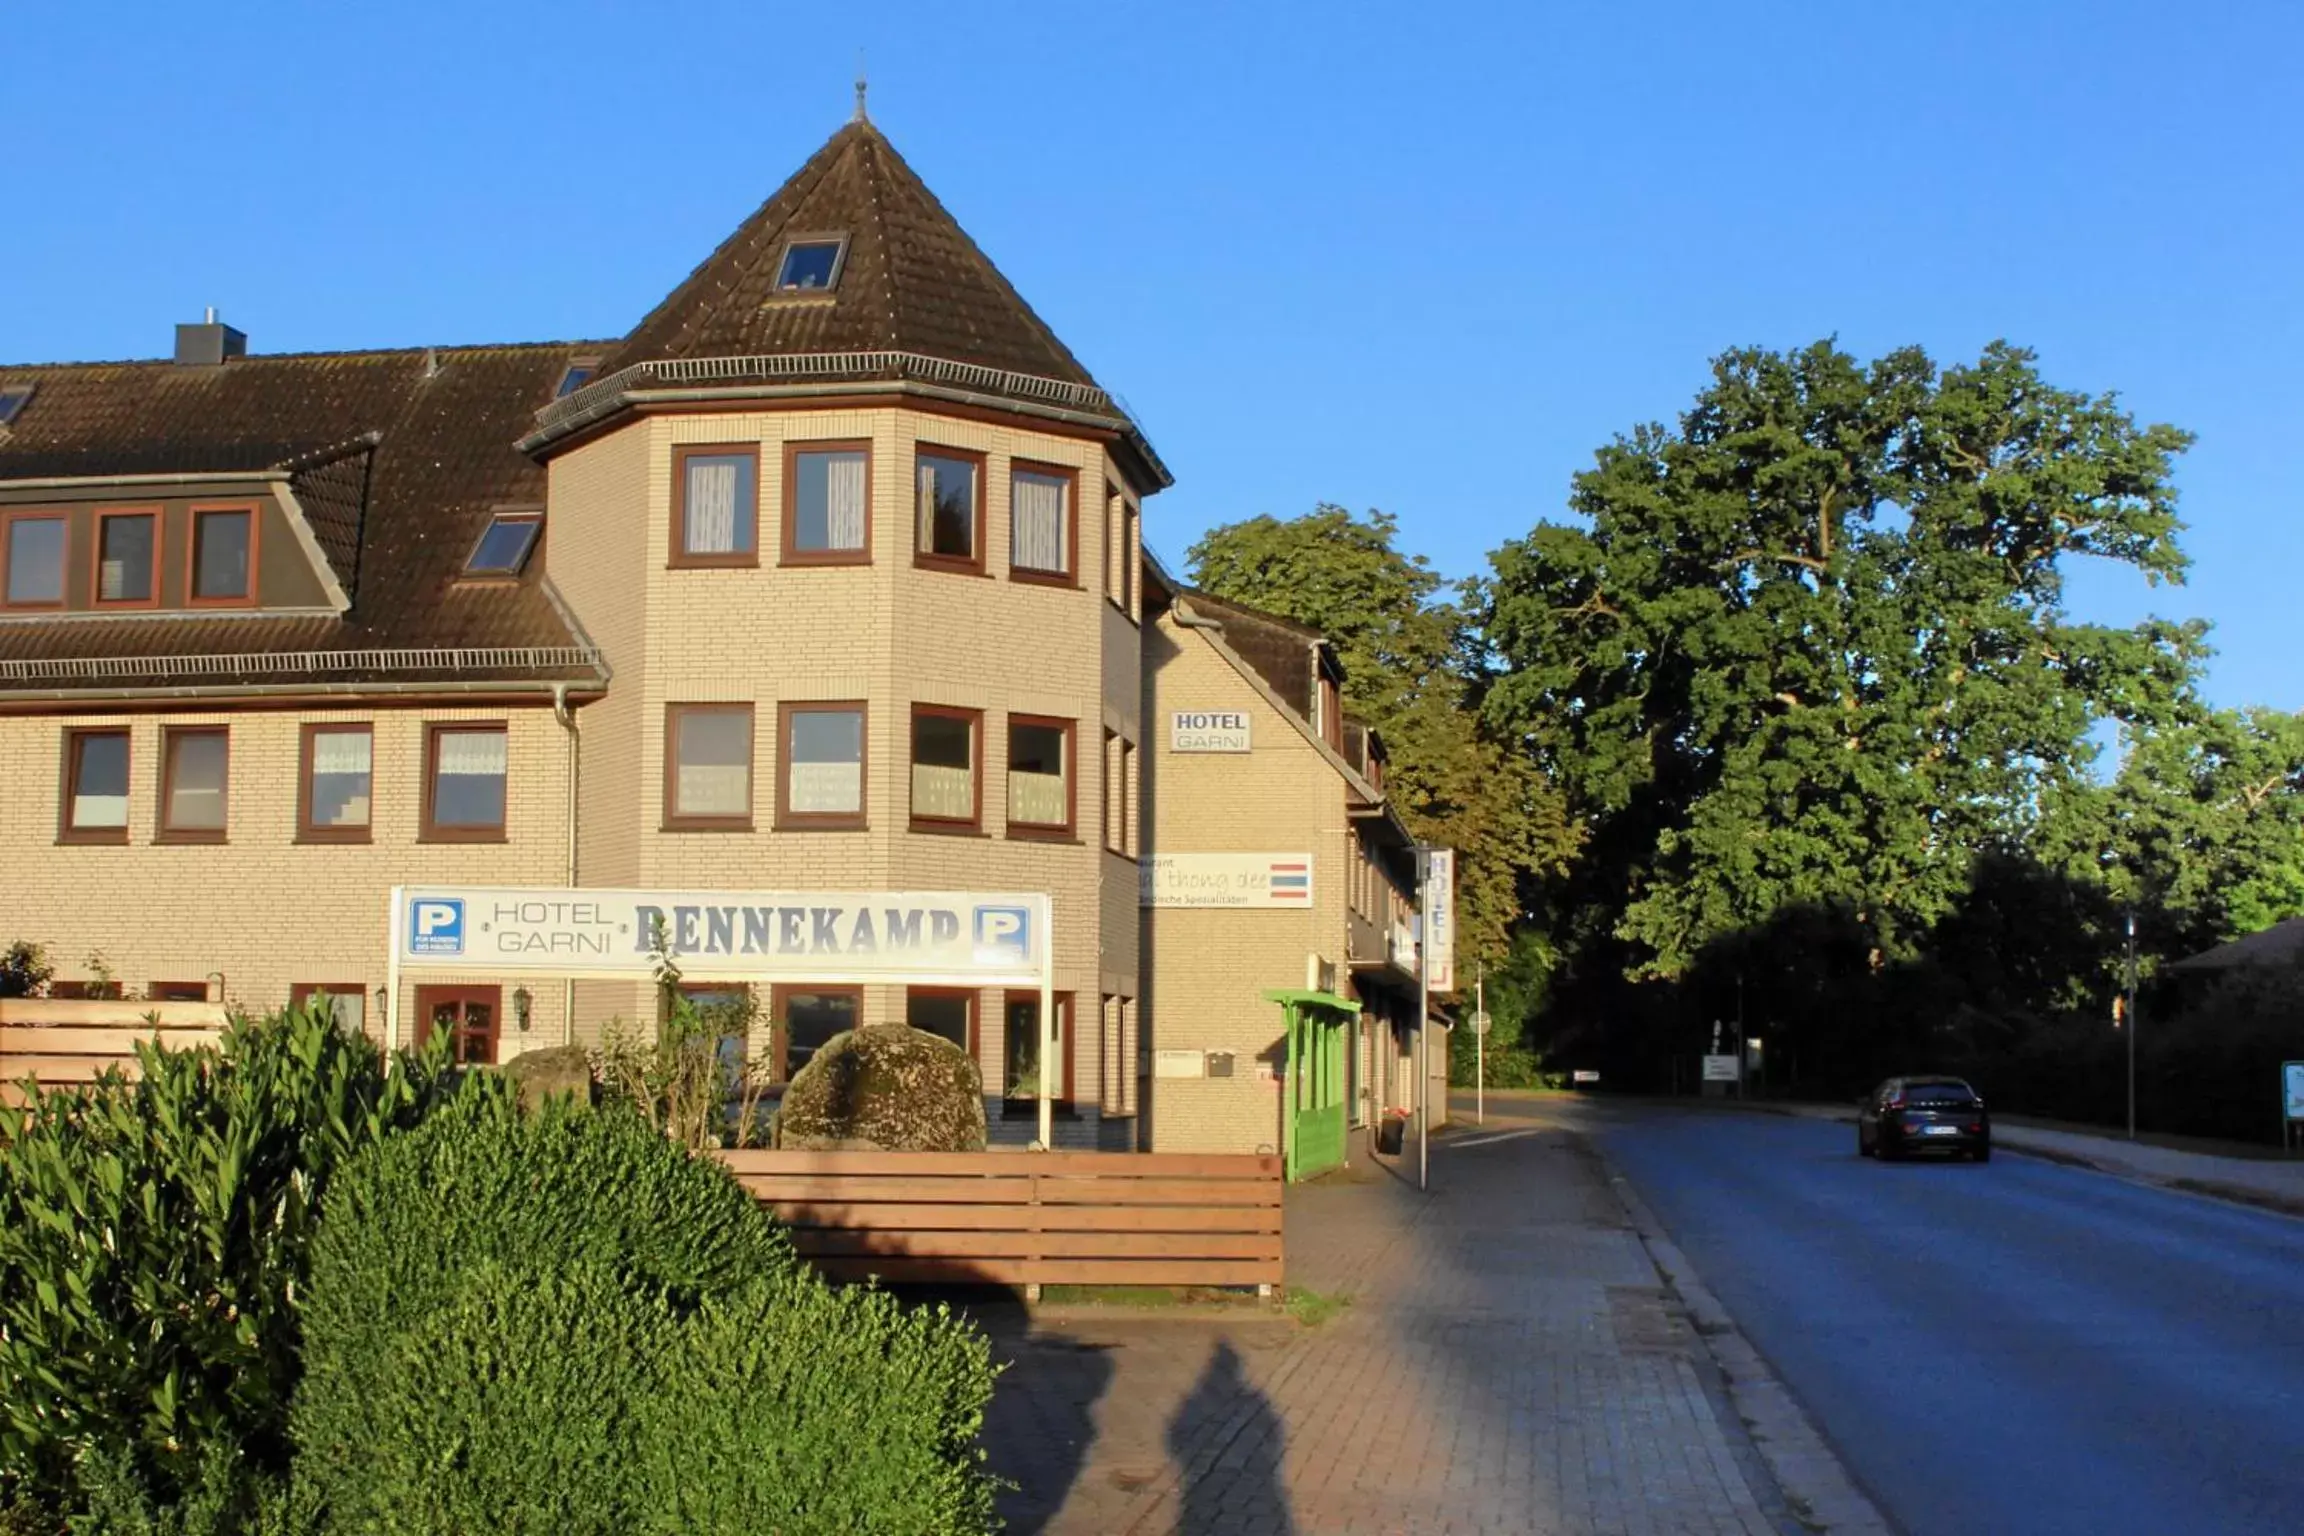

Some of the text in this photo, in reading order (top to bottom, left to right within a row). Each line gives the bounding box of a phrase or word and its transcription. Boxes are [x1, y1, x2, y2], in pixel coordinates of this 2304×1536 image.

[1177, 714, 1246, 729] HOTEL
[1177, 735, 1244, 748] GARNI
[1431, 856, 1448, 945] HOTEL
[418, 904, 457, 934] P
[494, 902, 614, 924] HOTEL
[982, 911, 1020, 944] P
[497, 931, 611, 954] GARNI
